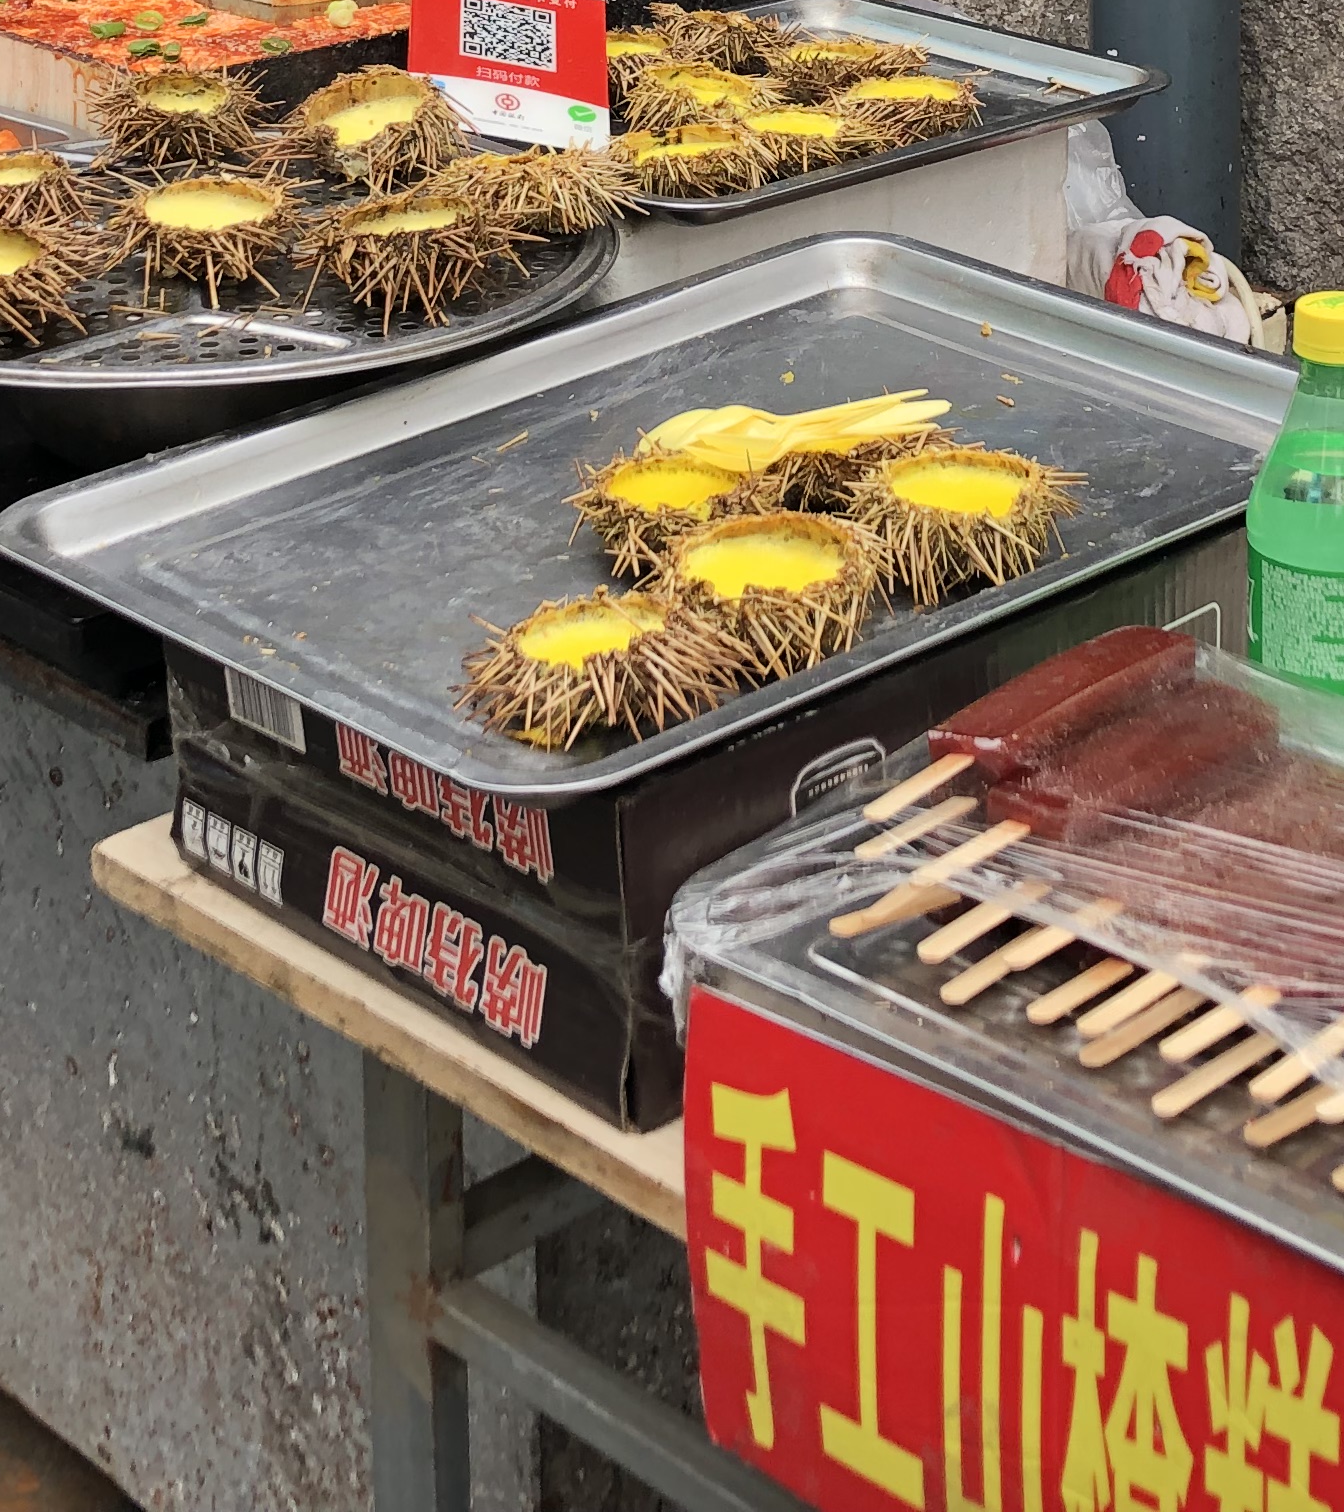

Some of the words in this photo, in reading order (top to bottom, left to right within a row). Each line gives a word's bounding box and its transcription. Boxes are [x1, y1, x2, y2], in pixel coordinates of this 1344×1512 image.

[475, 65, 542, 88] 扫码付款
[321, 845, 548, 1049] 崂特啤酒
